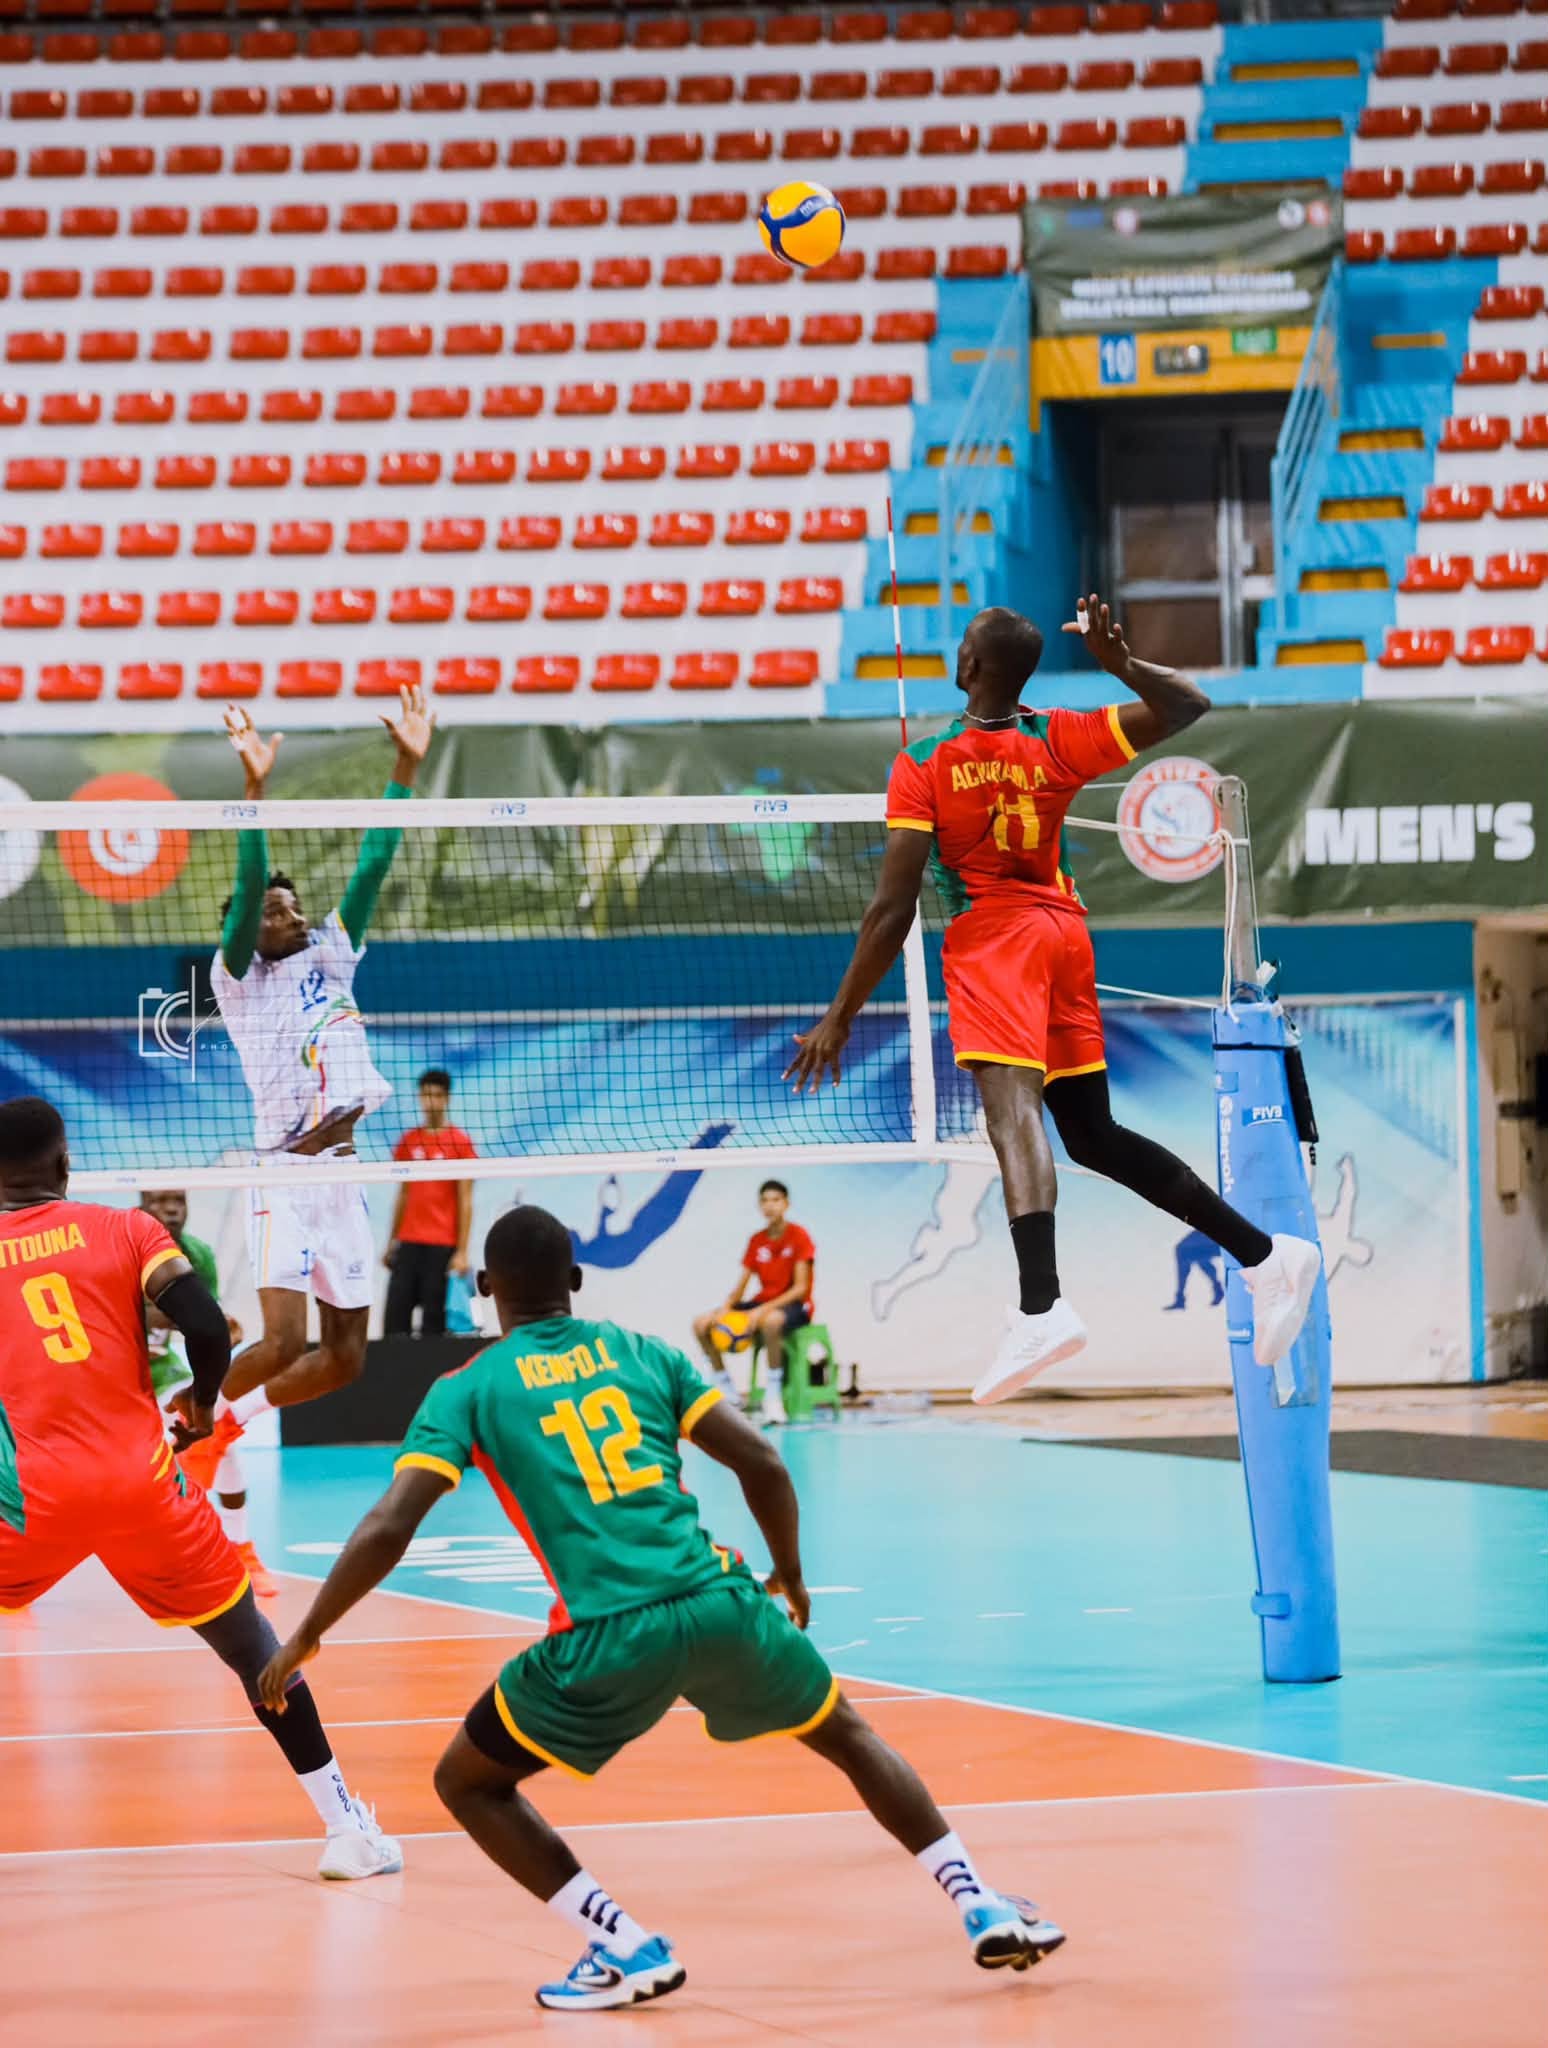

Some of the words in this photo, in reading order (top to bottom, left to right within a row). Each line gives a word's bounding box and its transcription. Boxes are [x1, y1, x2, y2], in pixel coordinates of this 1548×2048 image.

[1103, 338, 1133, 380] 10
[987, 792, 1040, 851] 11
[1305, 801, 1536, 865] MEN'S
[1251, 1105, 1283, 1121] FIVB
[20, 1271, 93, 1364] 9
[538, 1384, 665, 1506] 12
